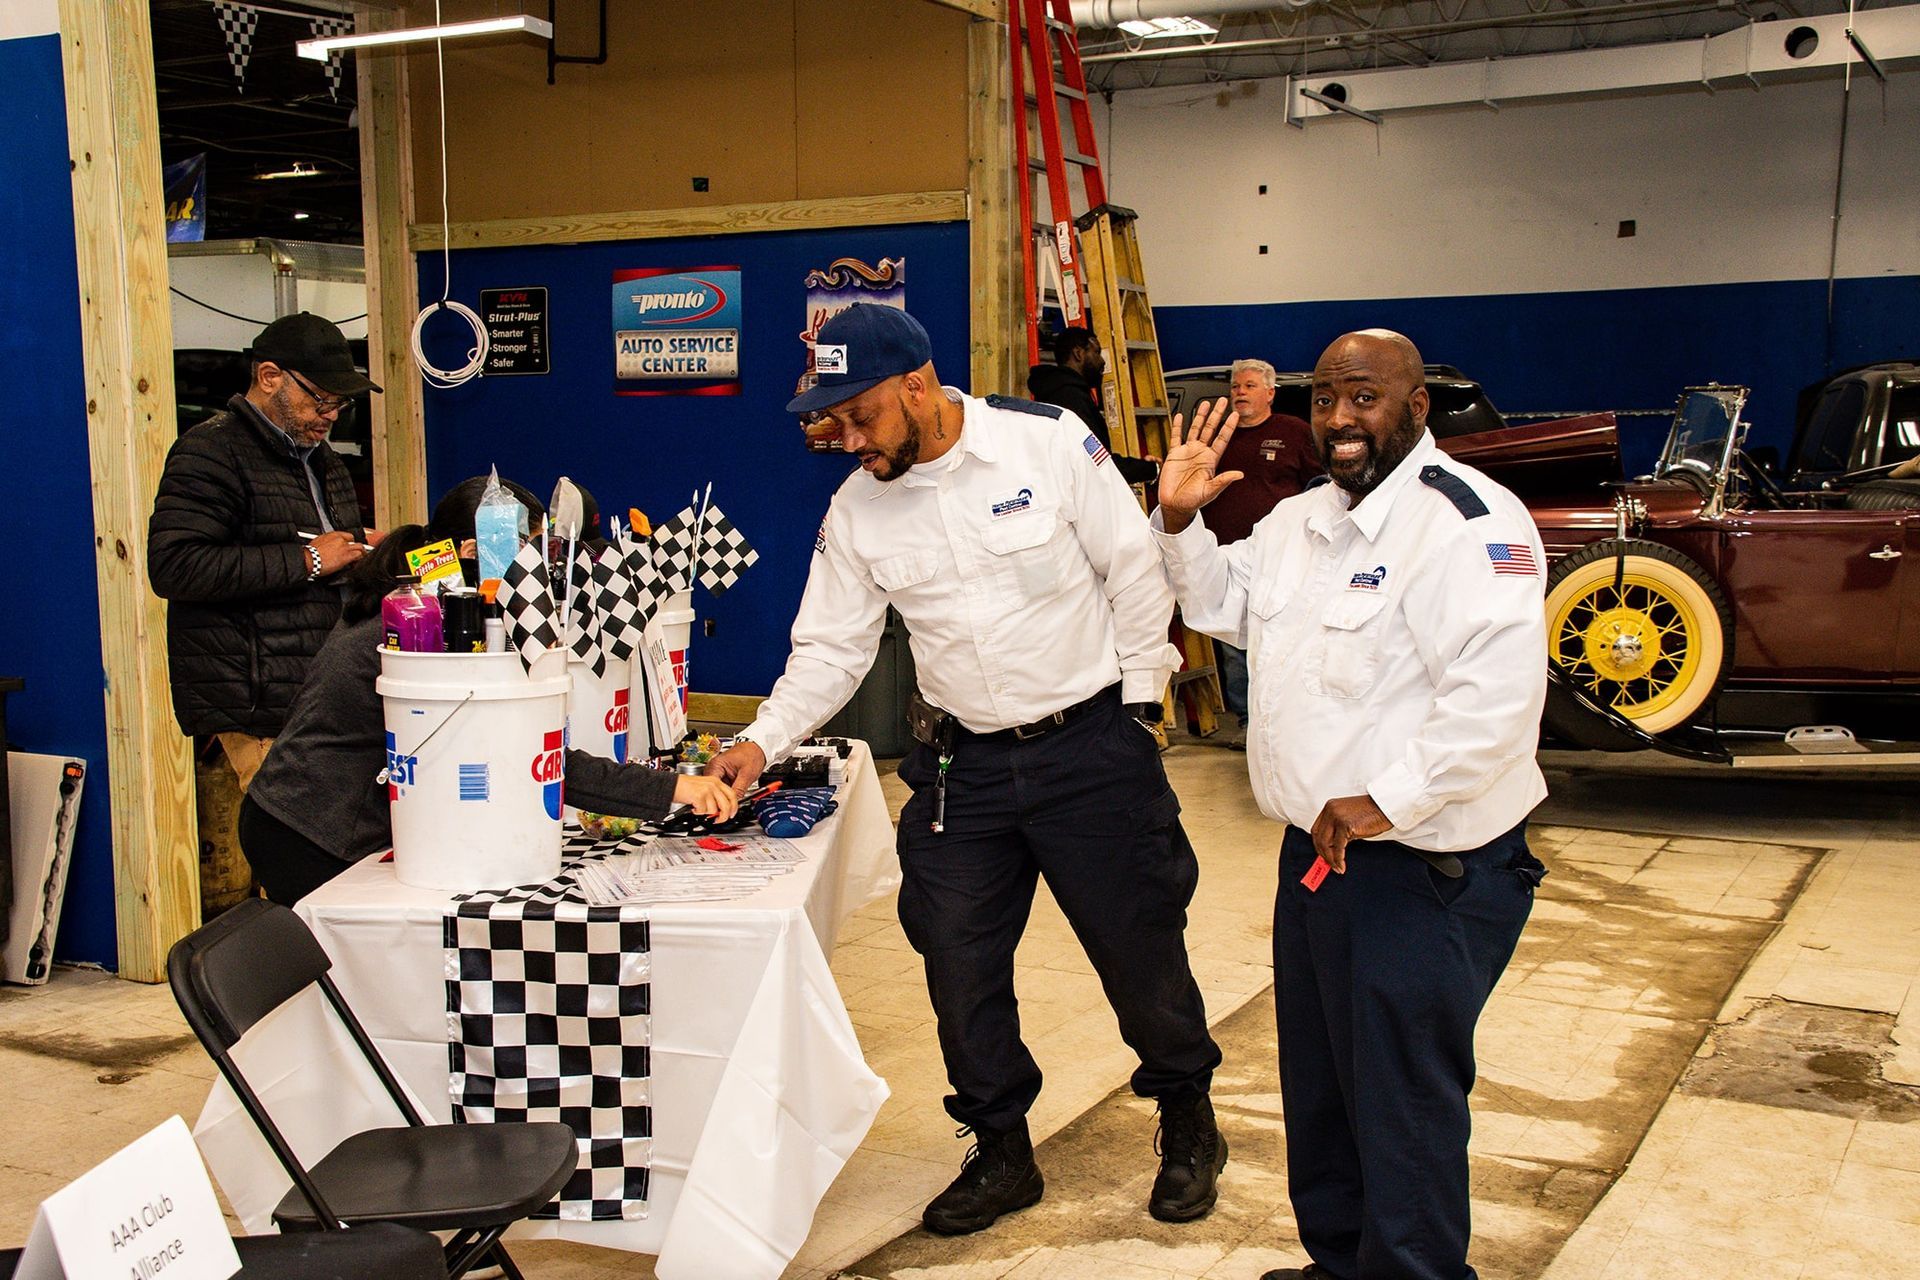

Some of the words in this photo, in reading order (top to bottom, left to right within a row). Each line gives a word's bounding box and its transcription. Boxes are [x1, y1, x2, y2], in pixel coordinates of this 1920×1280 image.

[632, 290, 705, 314] pronto
[488, 312, 541, 323] Strut-Plus
[492, 329, 525, 339] Smarter
[492, 343, 528, 354] Stronger
[620, 338, 664, 354] AUTO
[669, 337, 734, 353] SERVICE
[493, 358, 514, 368] Safer
[642, 357, 708, 373] CENTER
[444, 541, 453, 551] 3
[415, 560, 435, 578] Little
[434, 552, 455, 567] Trees
[531, 750, 566, 783] CAR
[110, 1216, 143, 1253] AAA
[142, 1193, 174, 1228] Club
[131, 1238, 184, 1280] Alliance
